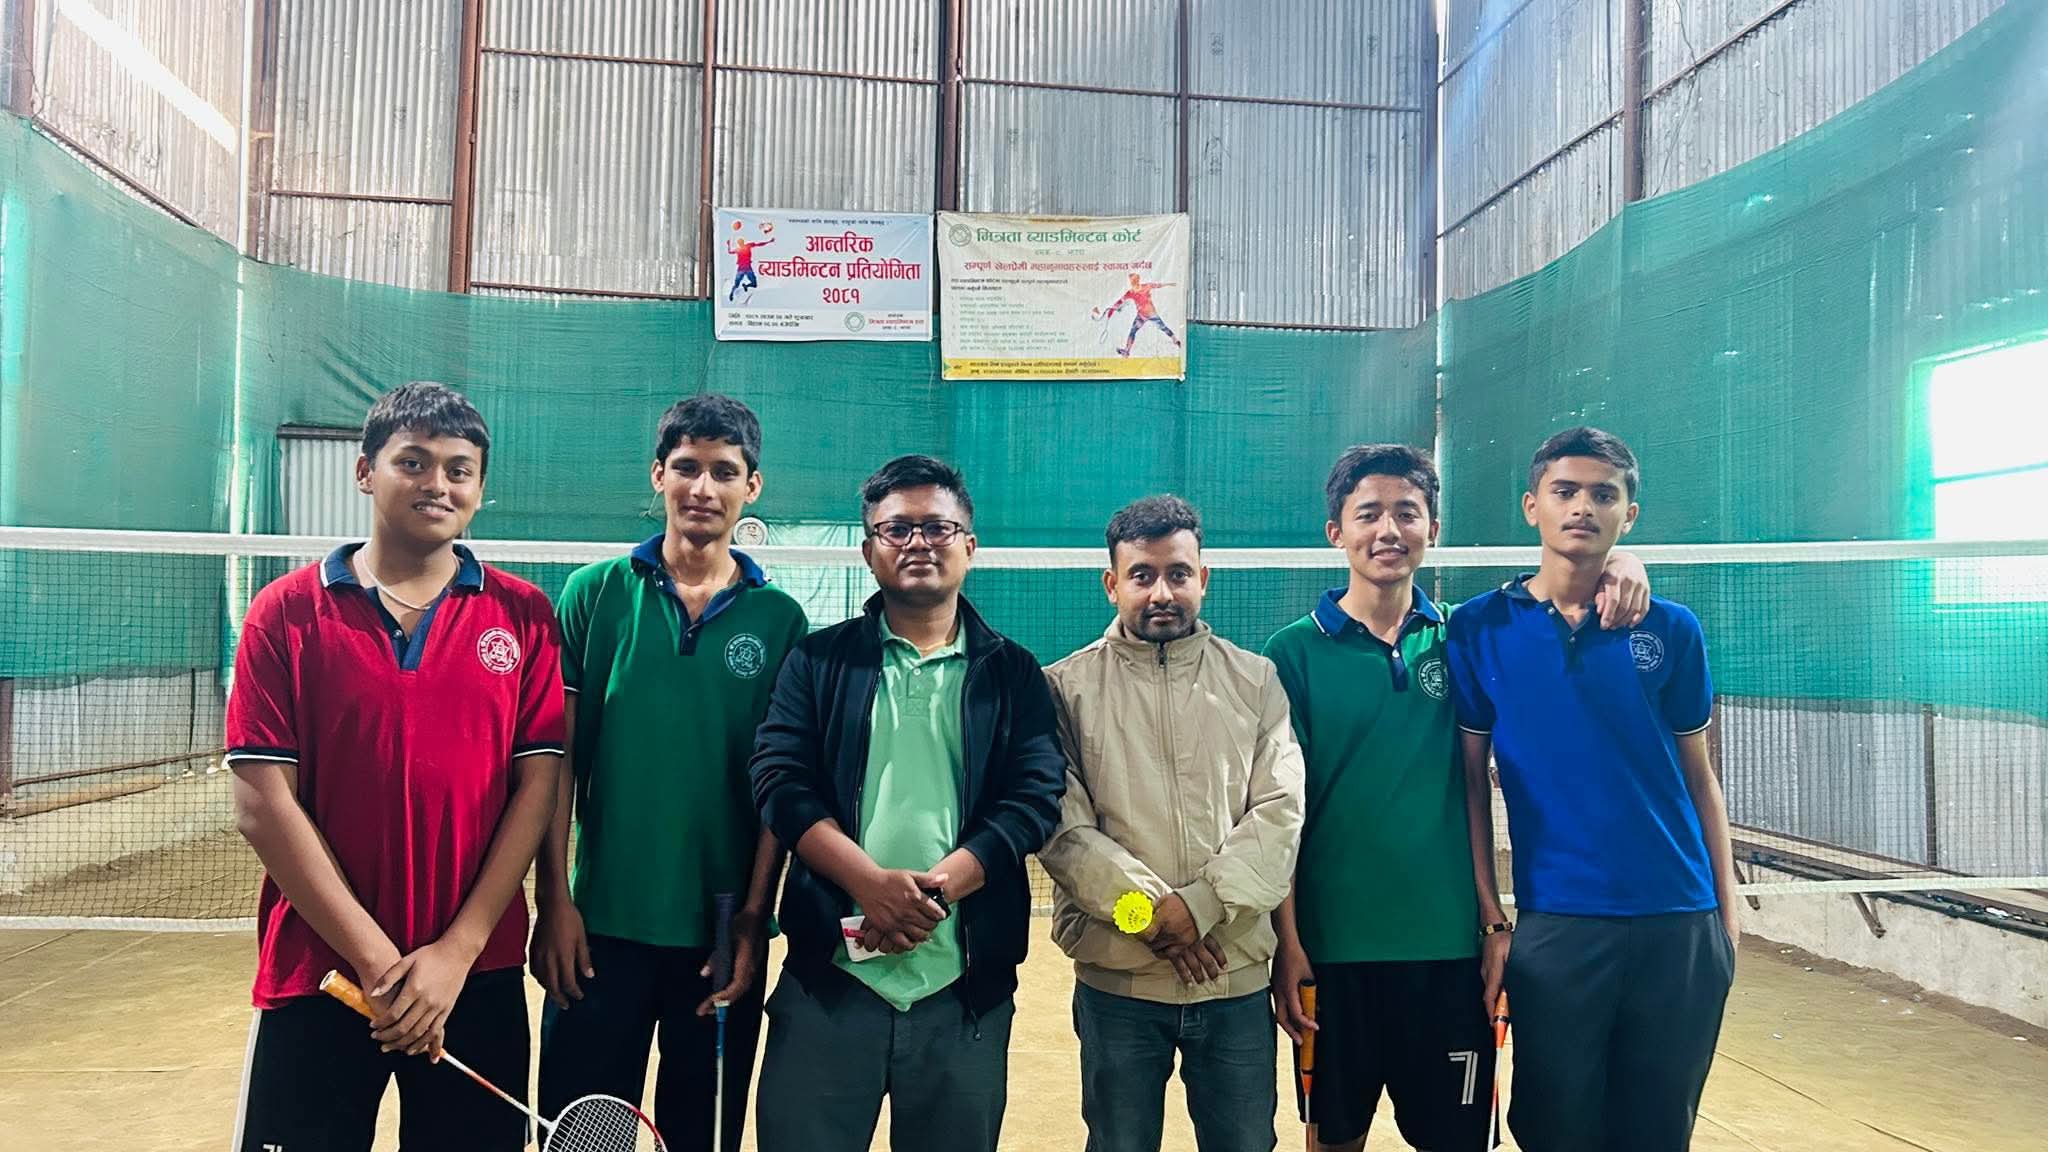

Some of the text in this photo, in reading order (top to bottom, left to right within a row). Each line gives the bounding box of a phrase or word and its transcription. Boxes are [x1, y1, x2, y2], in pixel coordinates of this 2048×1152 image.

[805, 231, 874, 253] आन्तरिक
[976, 228, 1021, 243] मित्रता
[1112, 228, 1142, 243] कोर्ट
[847, 257, 921, 281] प्रतियोगिता
[823, 288, 860, 304] २०८१
